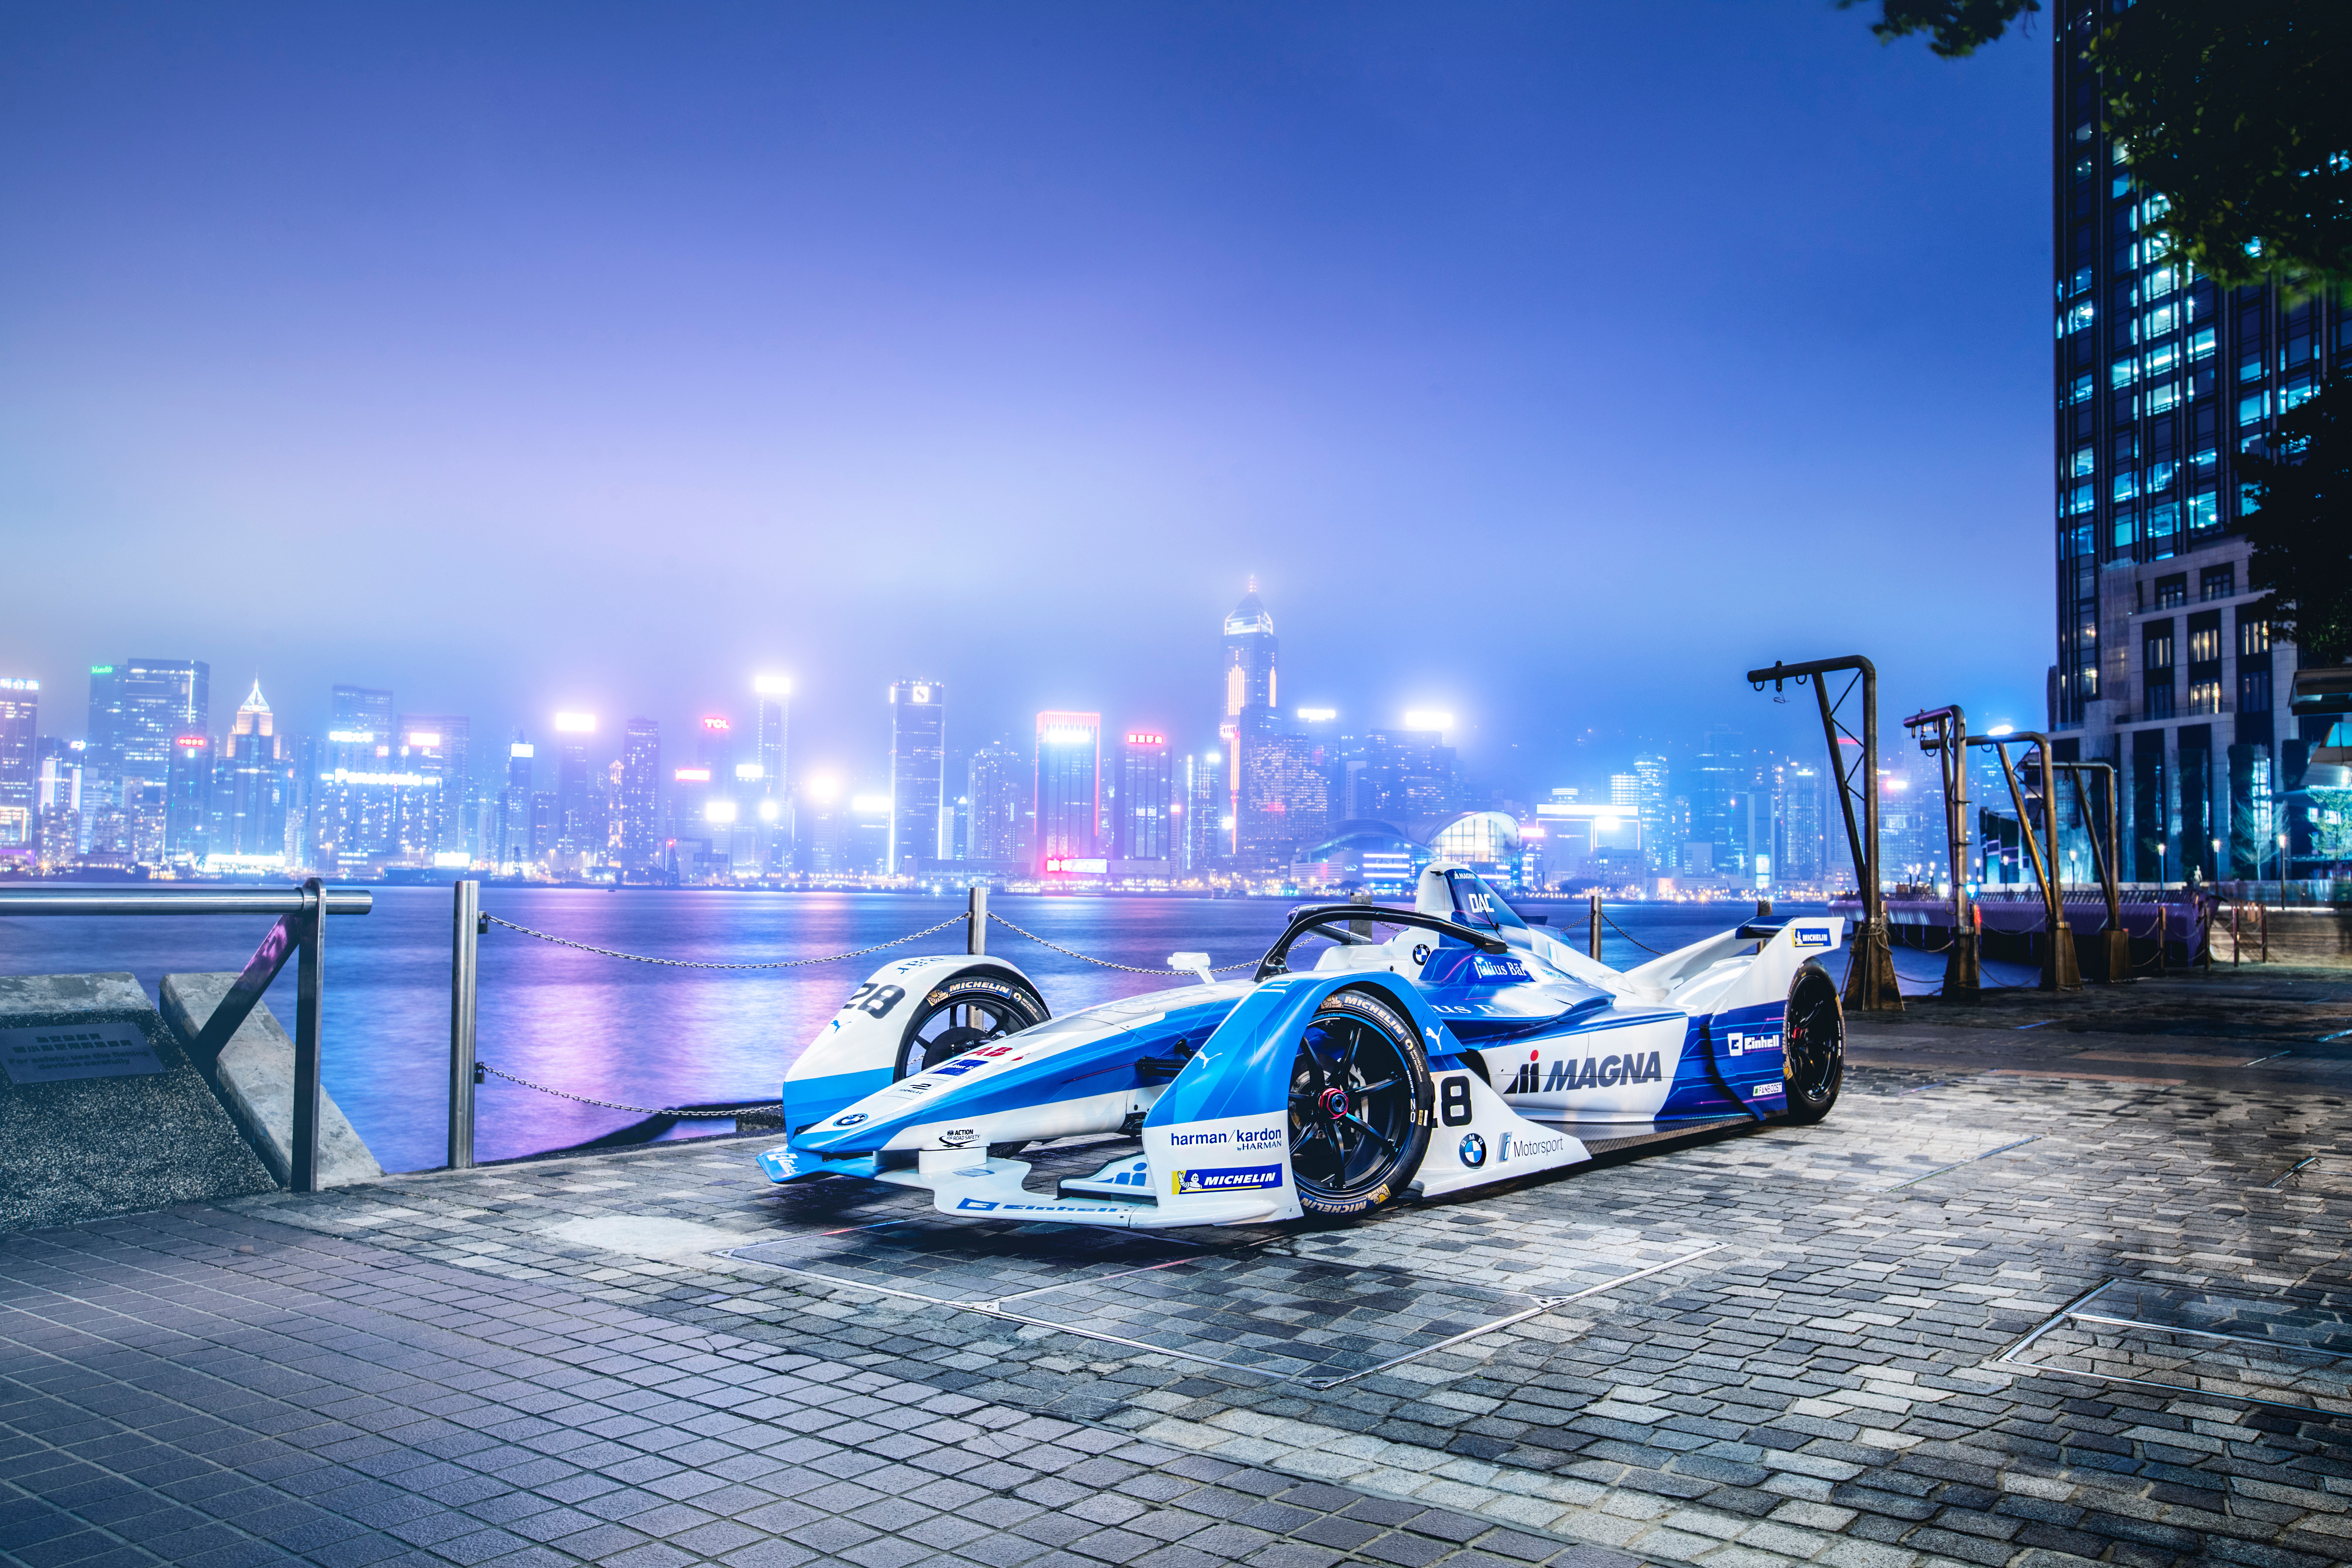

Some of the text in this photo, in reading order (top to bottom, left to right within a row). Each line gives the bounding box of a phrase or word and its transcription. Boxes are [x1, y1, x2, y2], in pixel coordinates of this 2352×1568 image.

[92, 666, 113, 674] Manulife
[705, 718, 729, 729] TCL
[1468, 894, 1495, 913] DAC
[1802, 934, 1828, 942] MICHELIN
[1473, 962, 1527, 979] Julius Bär
[949, 981, 1010, 994] MICHELIN
[843, 982, 906, 1019] 28
[1022, 998, 1037, 1013] MICHELIN
[1344, 996, 1404, 1035] MICHELIN
[1745, 1034, 1779, 1050] Einhell
[38, 1058, 130, 1069] devices carefully
[1412, 1049, 1424, 1072] MICHELIN
[1414, 1060, 1422, 1082] Performance
[1542, 1051, 1662, 1092] MAGNA
[1406, 1070, 1415, 1094] RACING
[1755, 1083, 1782, 1095] #FANBOOST
[1171, 1128, 1281, 1145] harman/kardon
[1461, 1134, 1484, 1146] BMW
[1242, 1140, 1282, 1151] HARMAN
[1514, 1136, 1563, 1158] Motorsport
[1204, 1172, 1276, 1186] MICHELIN
[1003, 1204, 1118, 1212] Einhell
[1300, 1197, 1367, 1213] MICHELIN
